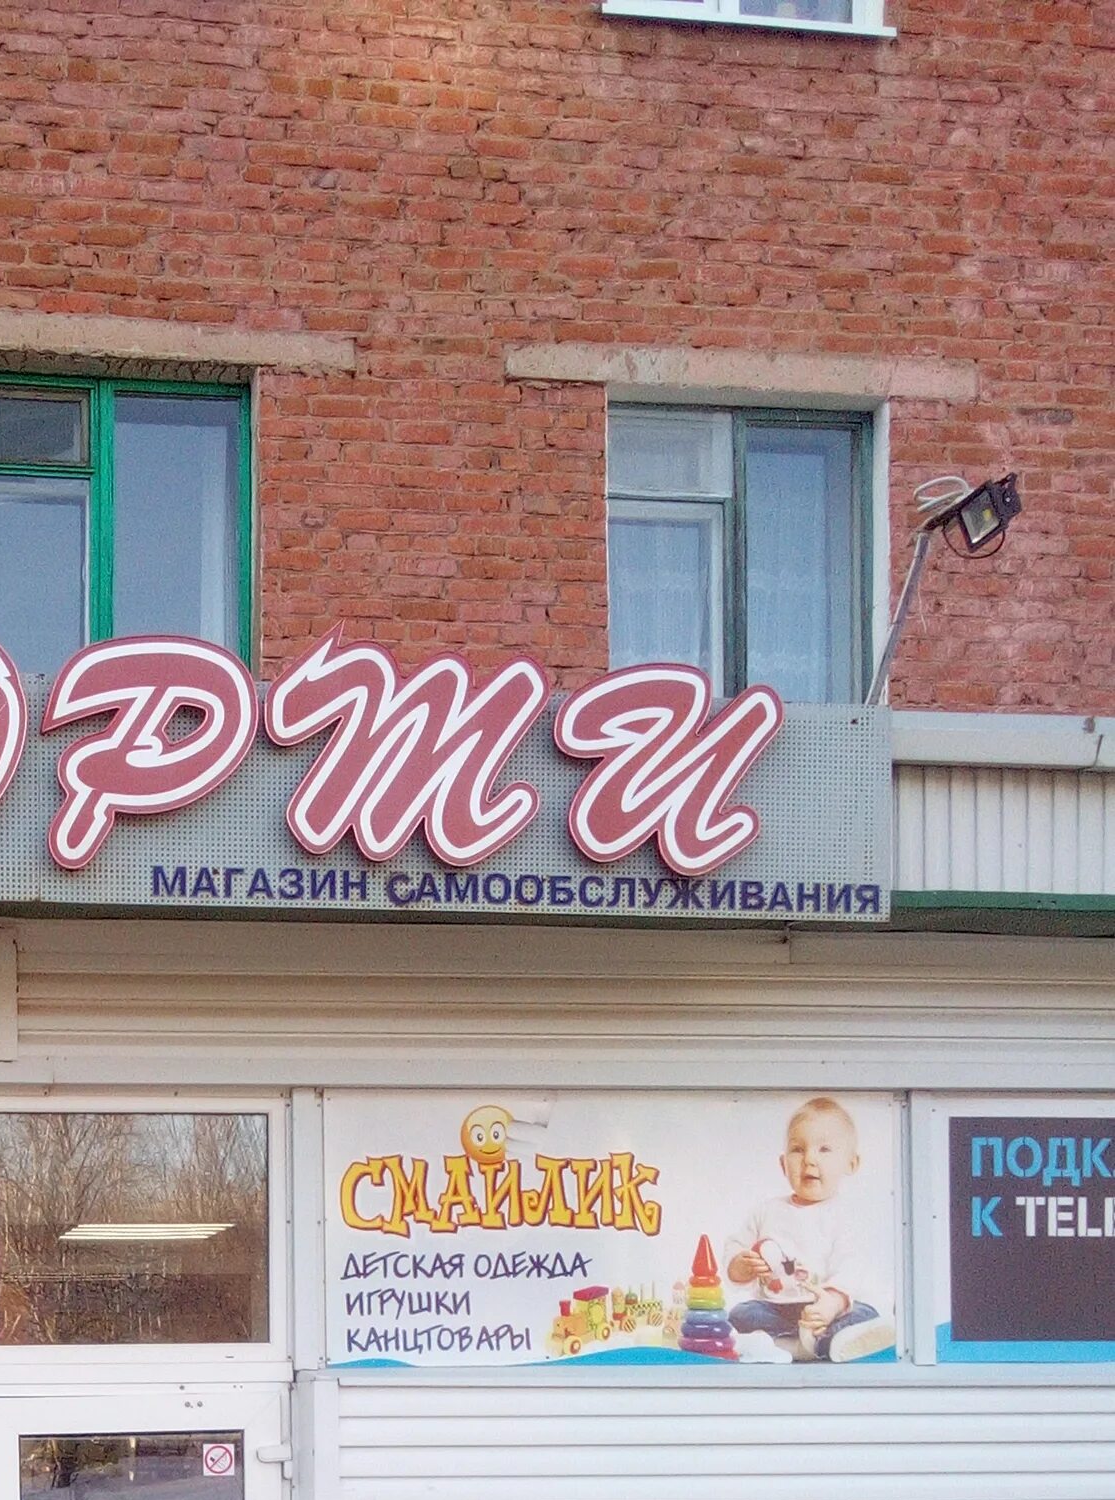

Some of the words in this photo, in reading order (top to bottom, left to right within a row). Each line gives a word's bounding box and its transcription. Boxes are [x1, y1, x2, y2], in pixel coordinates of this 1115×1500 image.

[151, 864, 369, 902] МАГАЗИН
[385, 870, 881, 915] САМООБСЛУЖИВАНИЯ
[972, 1136, 1115, 1187] ПОДК
[972, 1196, 1003, 1237] К
[341, 1251, 465, 1281] ДЕТСКАЯ
[473, 1251, 593, 1279] ОДЕЖДА
[345, 1288, 471, 1320] ИГРУШКИ
[346, 1324, 532, 1355] КАНЦТОВАРЫ
